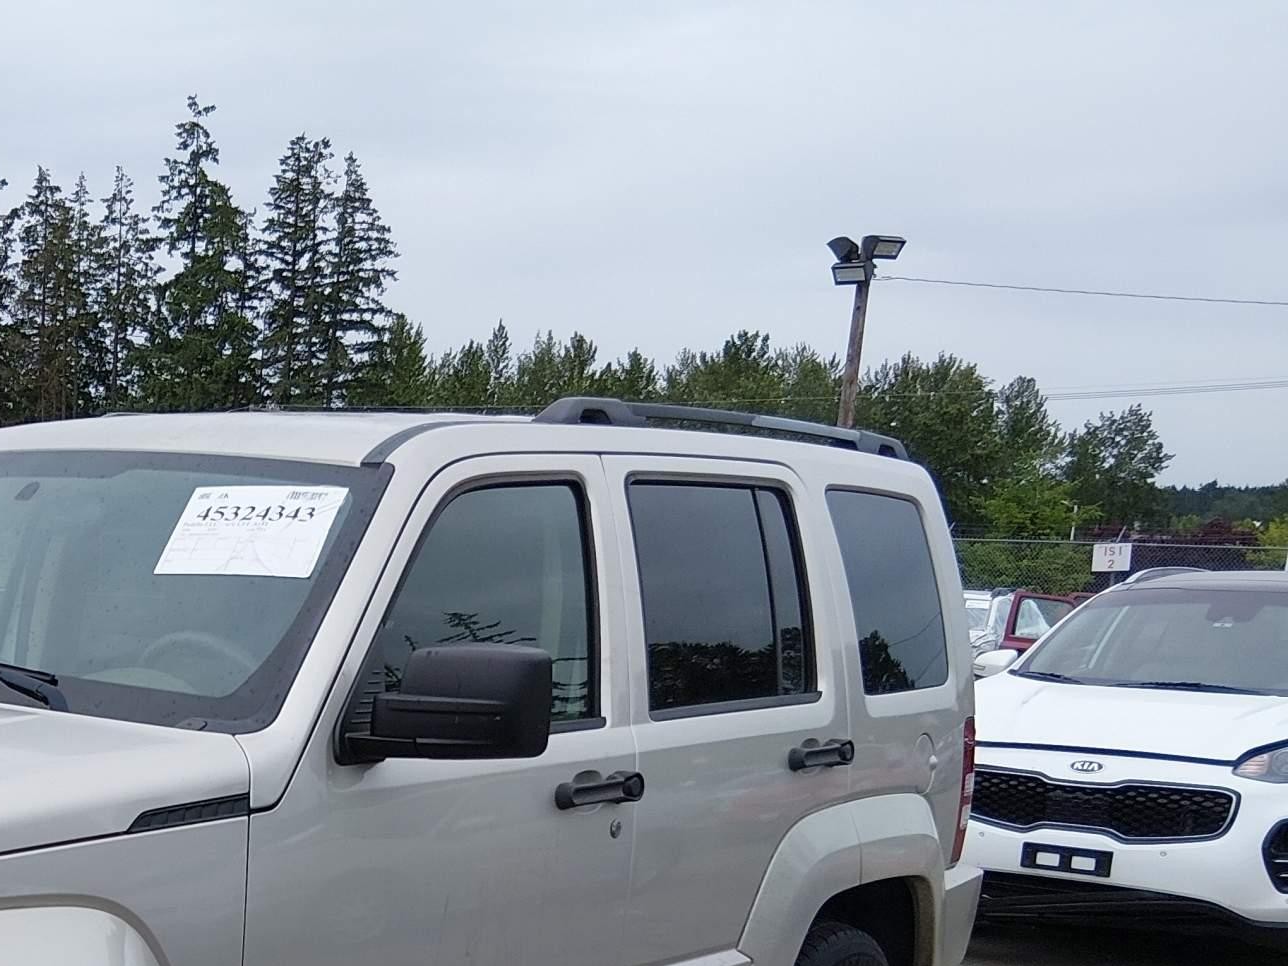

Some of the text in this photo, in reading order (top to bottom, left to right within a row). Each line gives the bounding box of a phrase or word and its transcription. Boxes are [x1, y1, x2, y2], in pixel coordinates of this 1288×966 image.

[196, 505, 317, 522] 45324343
[1107, 559, 1115, 569] 2
[1073, 760, 1099, 771] KIA
